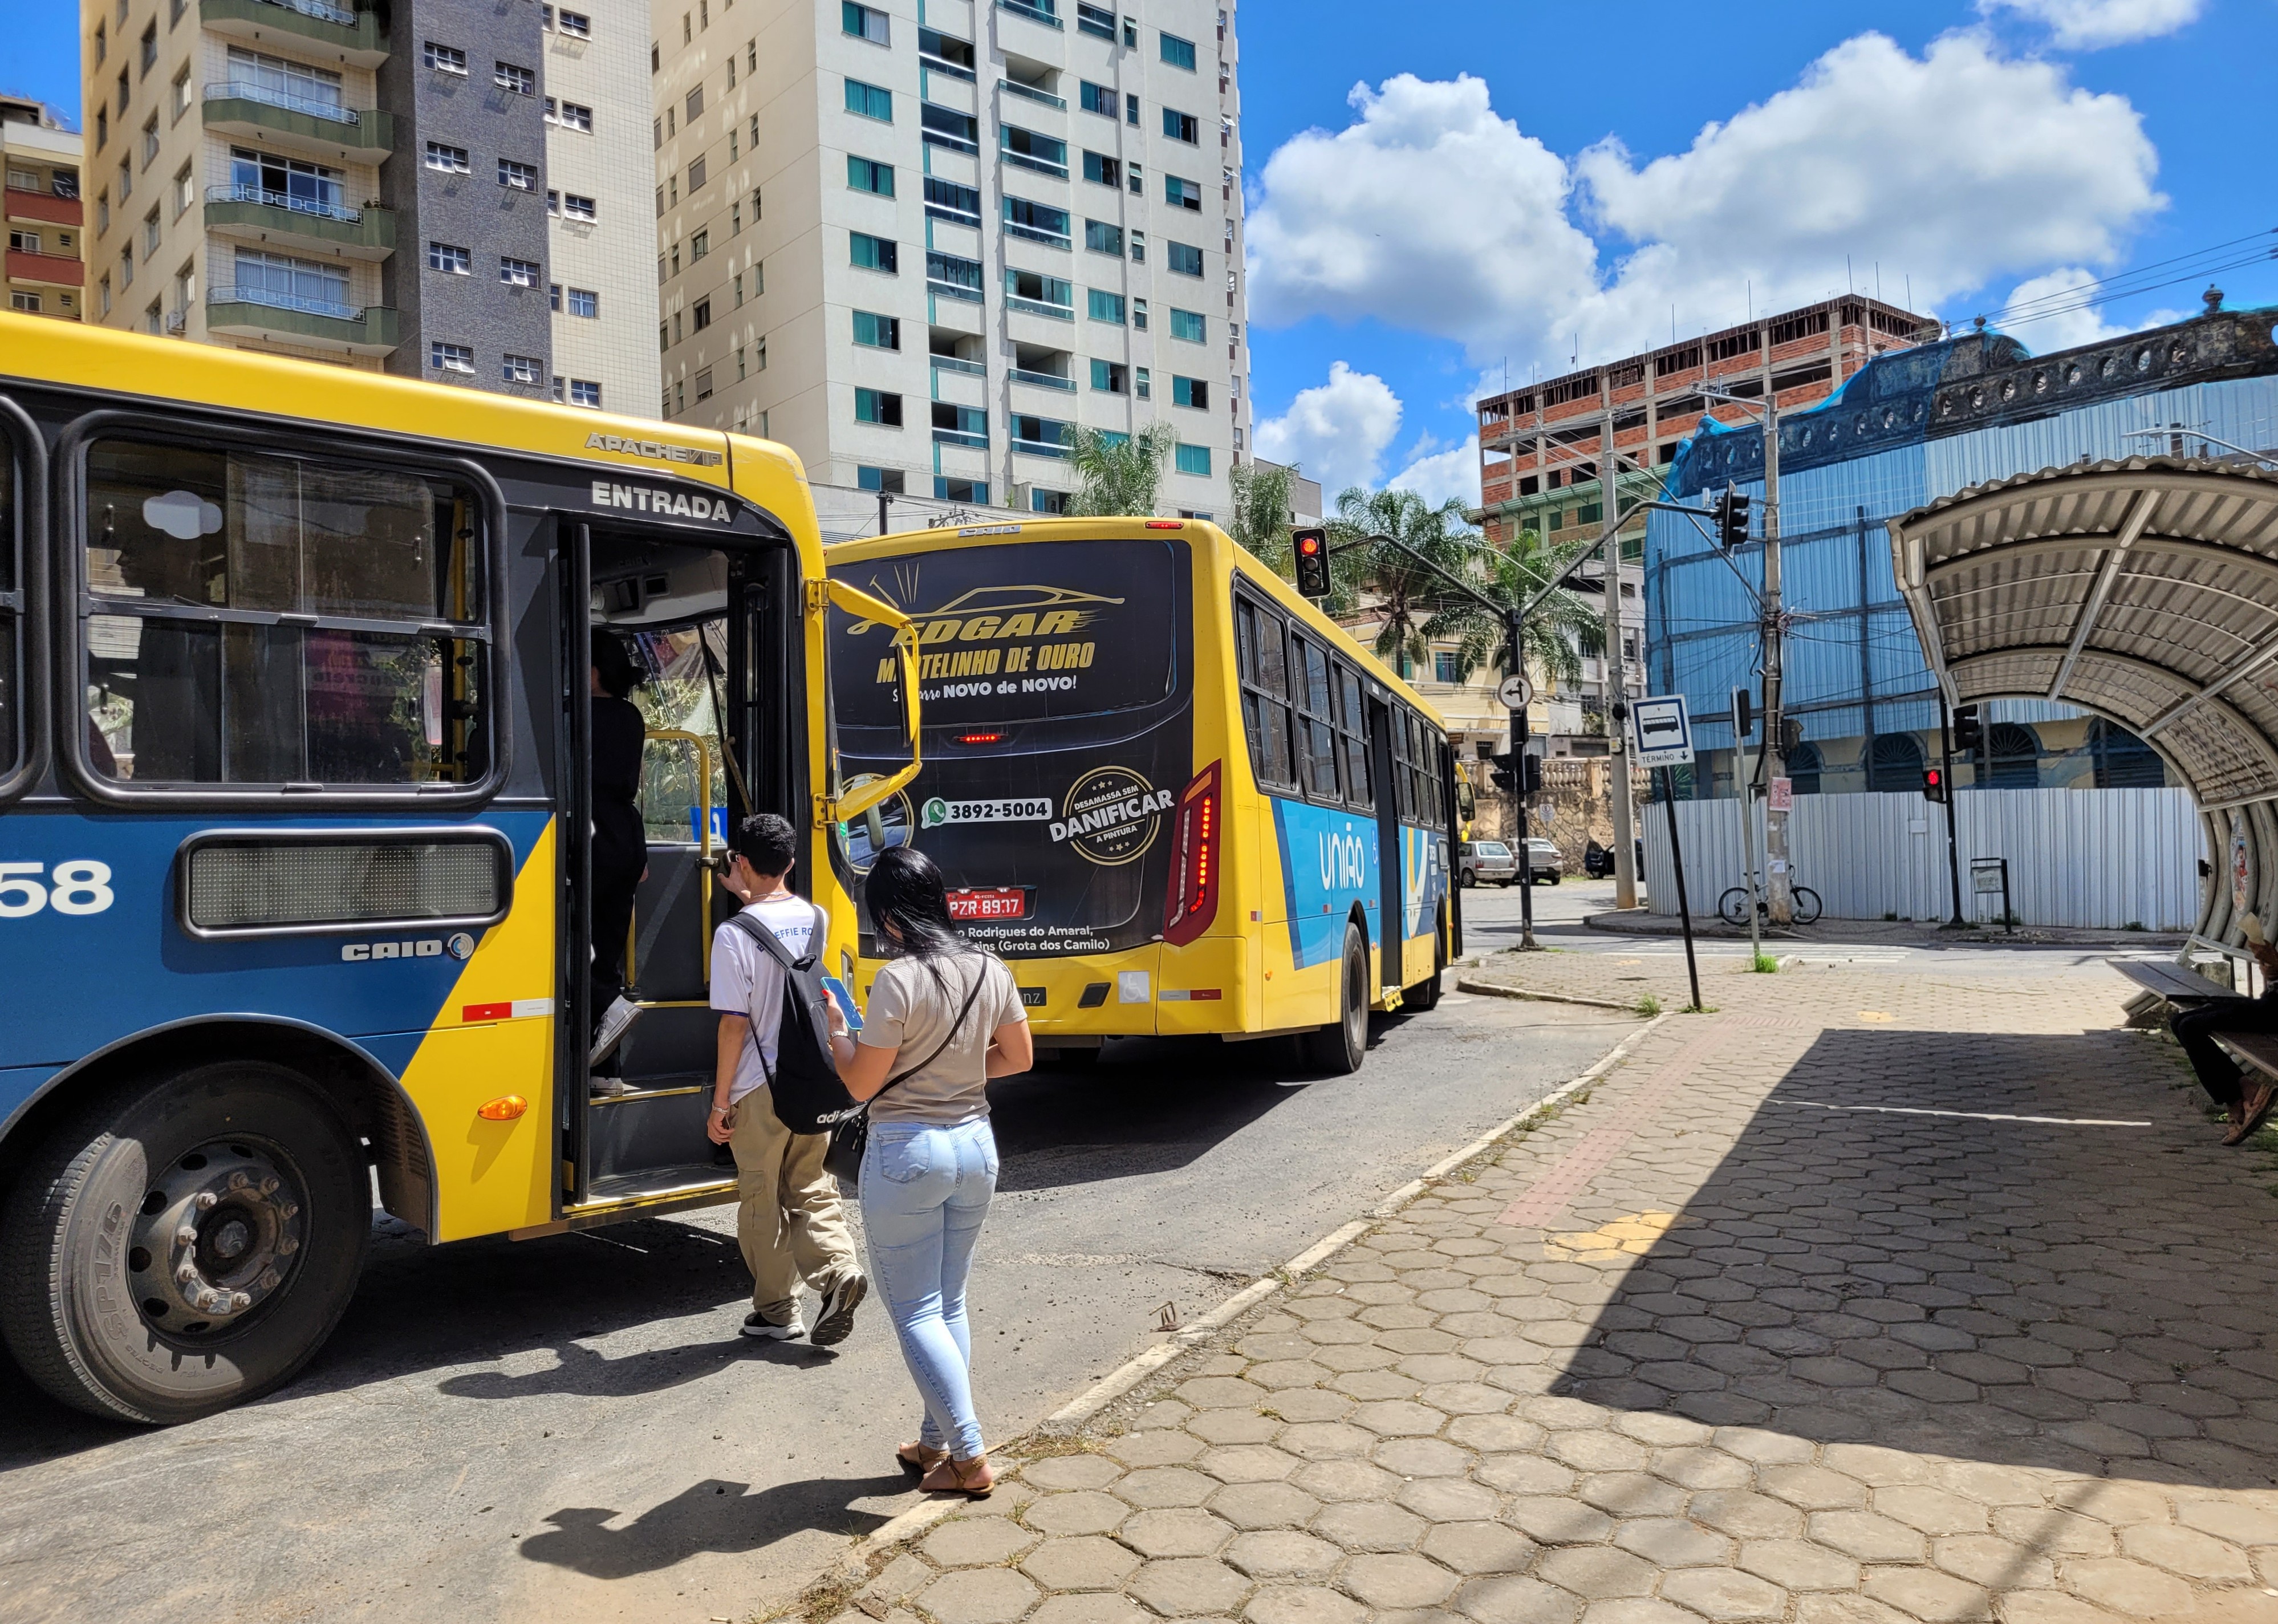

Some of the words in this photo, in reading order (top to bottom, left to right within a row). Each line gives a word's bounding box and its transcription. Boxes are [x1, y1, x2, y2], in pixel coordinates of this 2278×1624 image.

[592, 481, 731, 523] ENTRADA
[888, 610, 1081, 648] EDGAR
[876, 649, 1001, 684] MTELINHO
[1005, 647, 1032, 673] DE
[1036, 642, 1095, 671] OURO
[919, 689, 940, 701] arro
[944, 682, 992, 699] NOVO
[997, 681, 1017, 695] de
[1022, 675, 1077, 692] NOVO!
[1642, 754, 1674, 764] TÉRMINO
[1074, 792, 1122, 810] DESAMASSA
[1122, 785, 1139, 795] SEM
[951, 802, 1047, 819] 3892-5004
[1049, 789, 1175, 842] DANIFICAR
[1103, 825, 1138, 841] PINTURA
[968, 926, 1025, 939] Rodrigues
[1029, 926, 1044, 936] do
[1048, 925, 1093, 937] Amaral,
[342, 940, 442, 961] CAIO
[998, 940, 1036, 952] (Grota
[1042, 940, 1060, 950] dos
[1064, 938, 1110, 951] Camilo)
